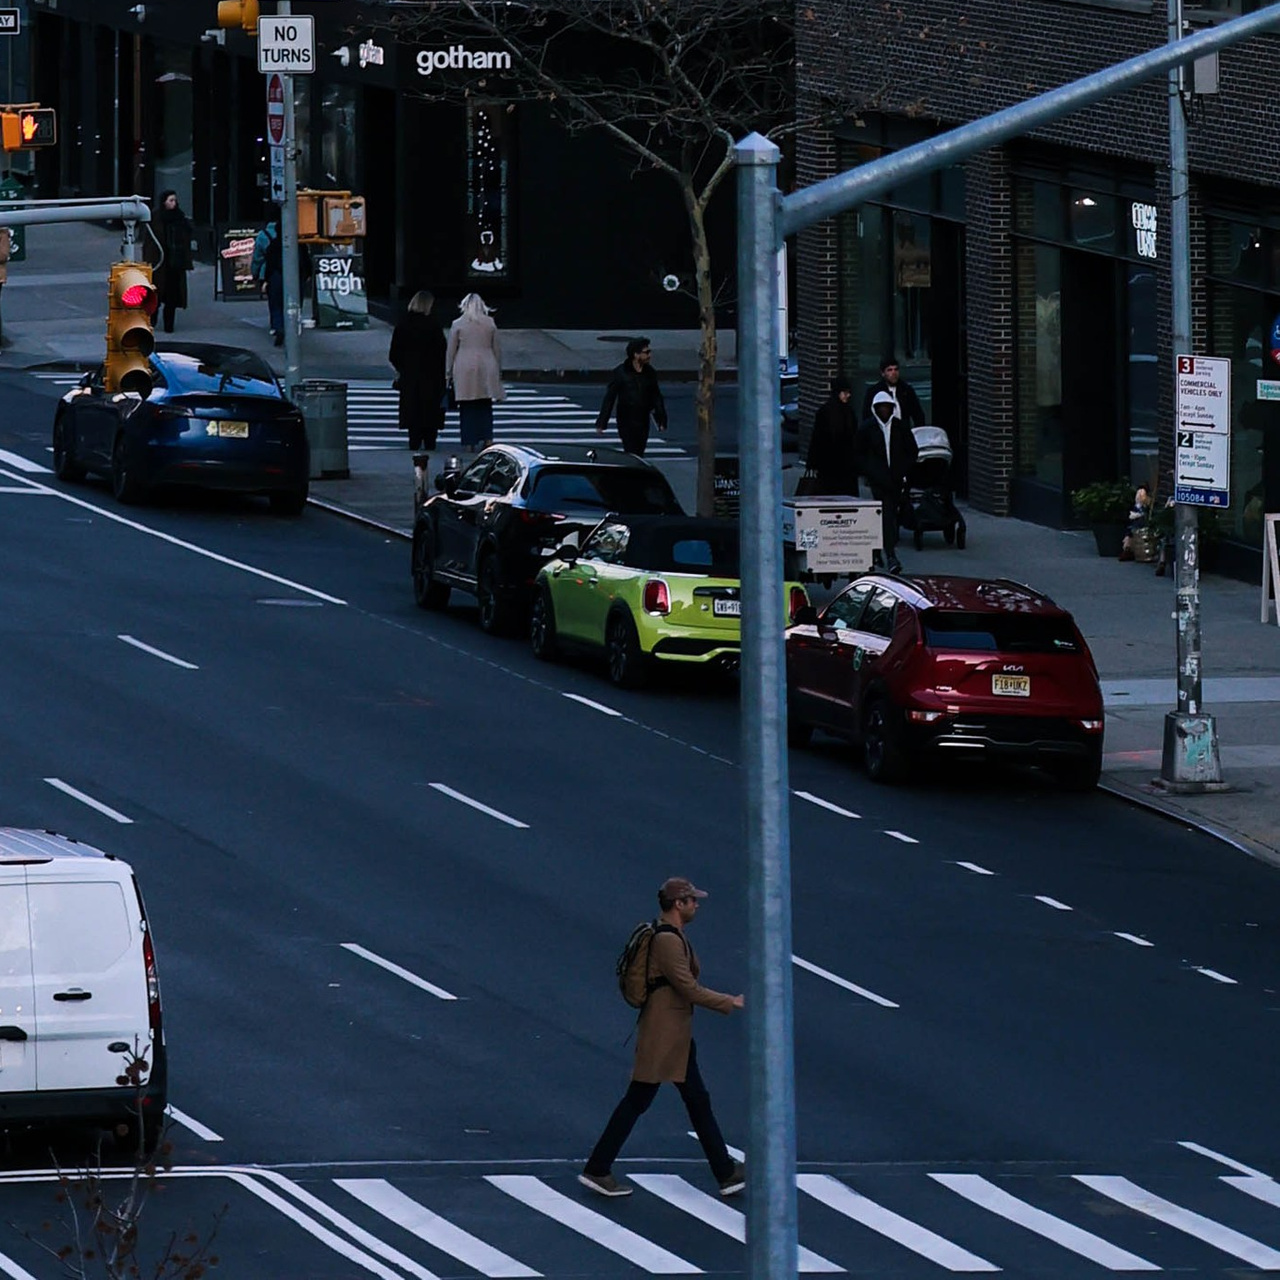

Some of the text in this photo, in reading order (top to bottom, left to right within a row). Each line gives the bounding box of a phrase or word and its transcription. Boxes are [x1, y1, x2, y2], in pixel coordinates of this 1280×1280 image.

[274, 26, 297, 41] NO
[262, 48, 311, 63] TURNS
[416, 45, 511, 75] gotham
[319, 257, 352, 276] say
[319, 273, 362, 296] high
[1181, 358, 1191, 373] 3
[1180, 379, 1217, 389] COMMERCIAL
[1180, 388, 1222, 398] VEHICLES ONLY
[1180, 433, 1190, 446] 2
[1002, 664, 1024, 672] KIA
